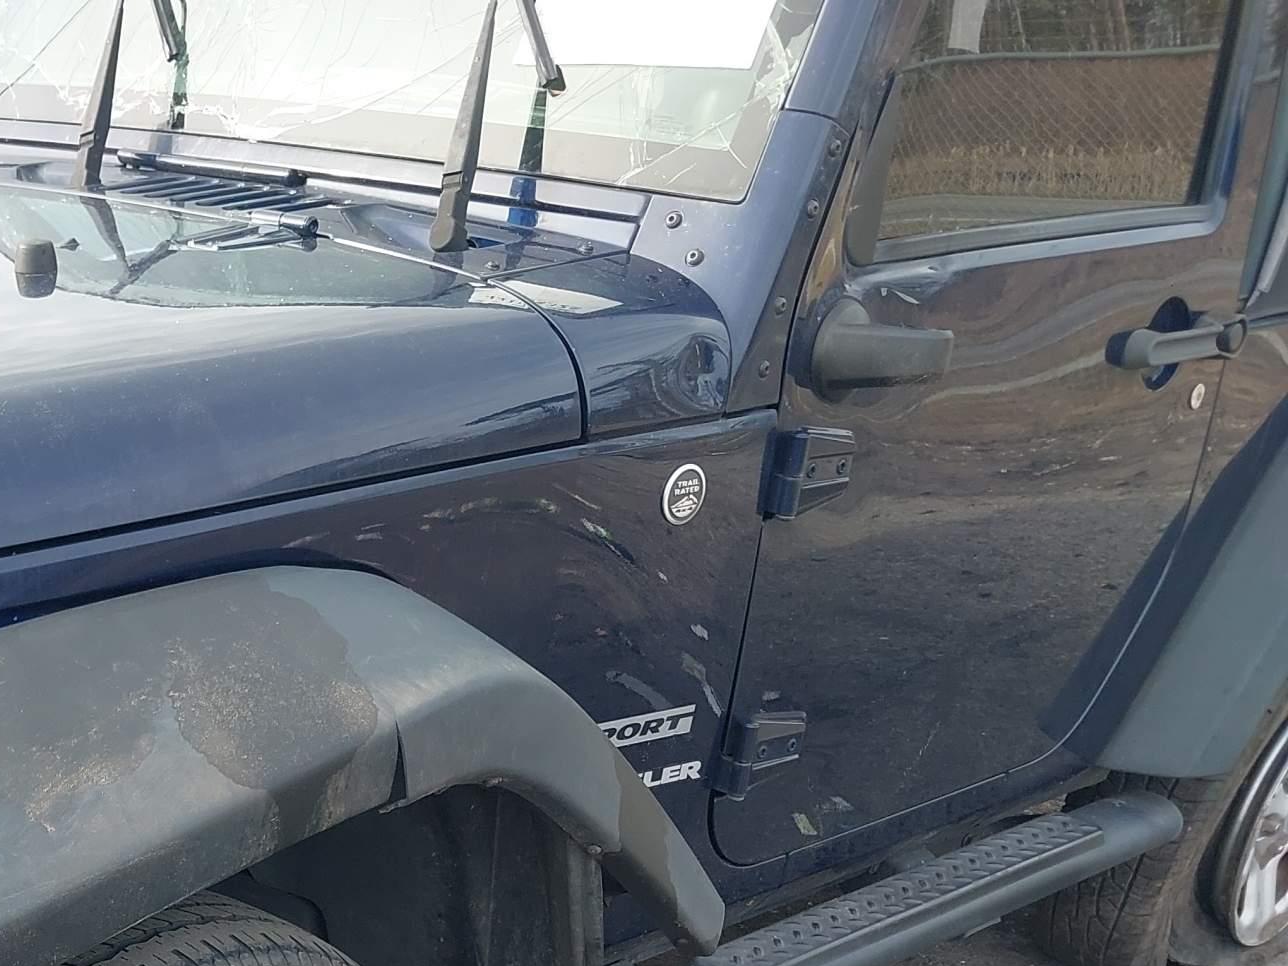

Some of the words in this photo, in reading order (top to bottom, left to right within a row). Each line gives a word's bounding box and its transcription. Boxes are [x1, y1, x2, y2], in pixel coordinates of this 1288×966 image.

[677, 479, 699, 488] TRAIL
[674, 486, 700, 496] RATED
[638, 760, 702, 788] LER
